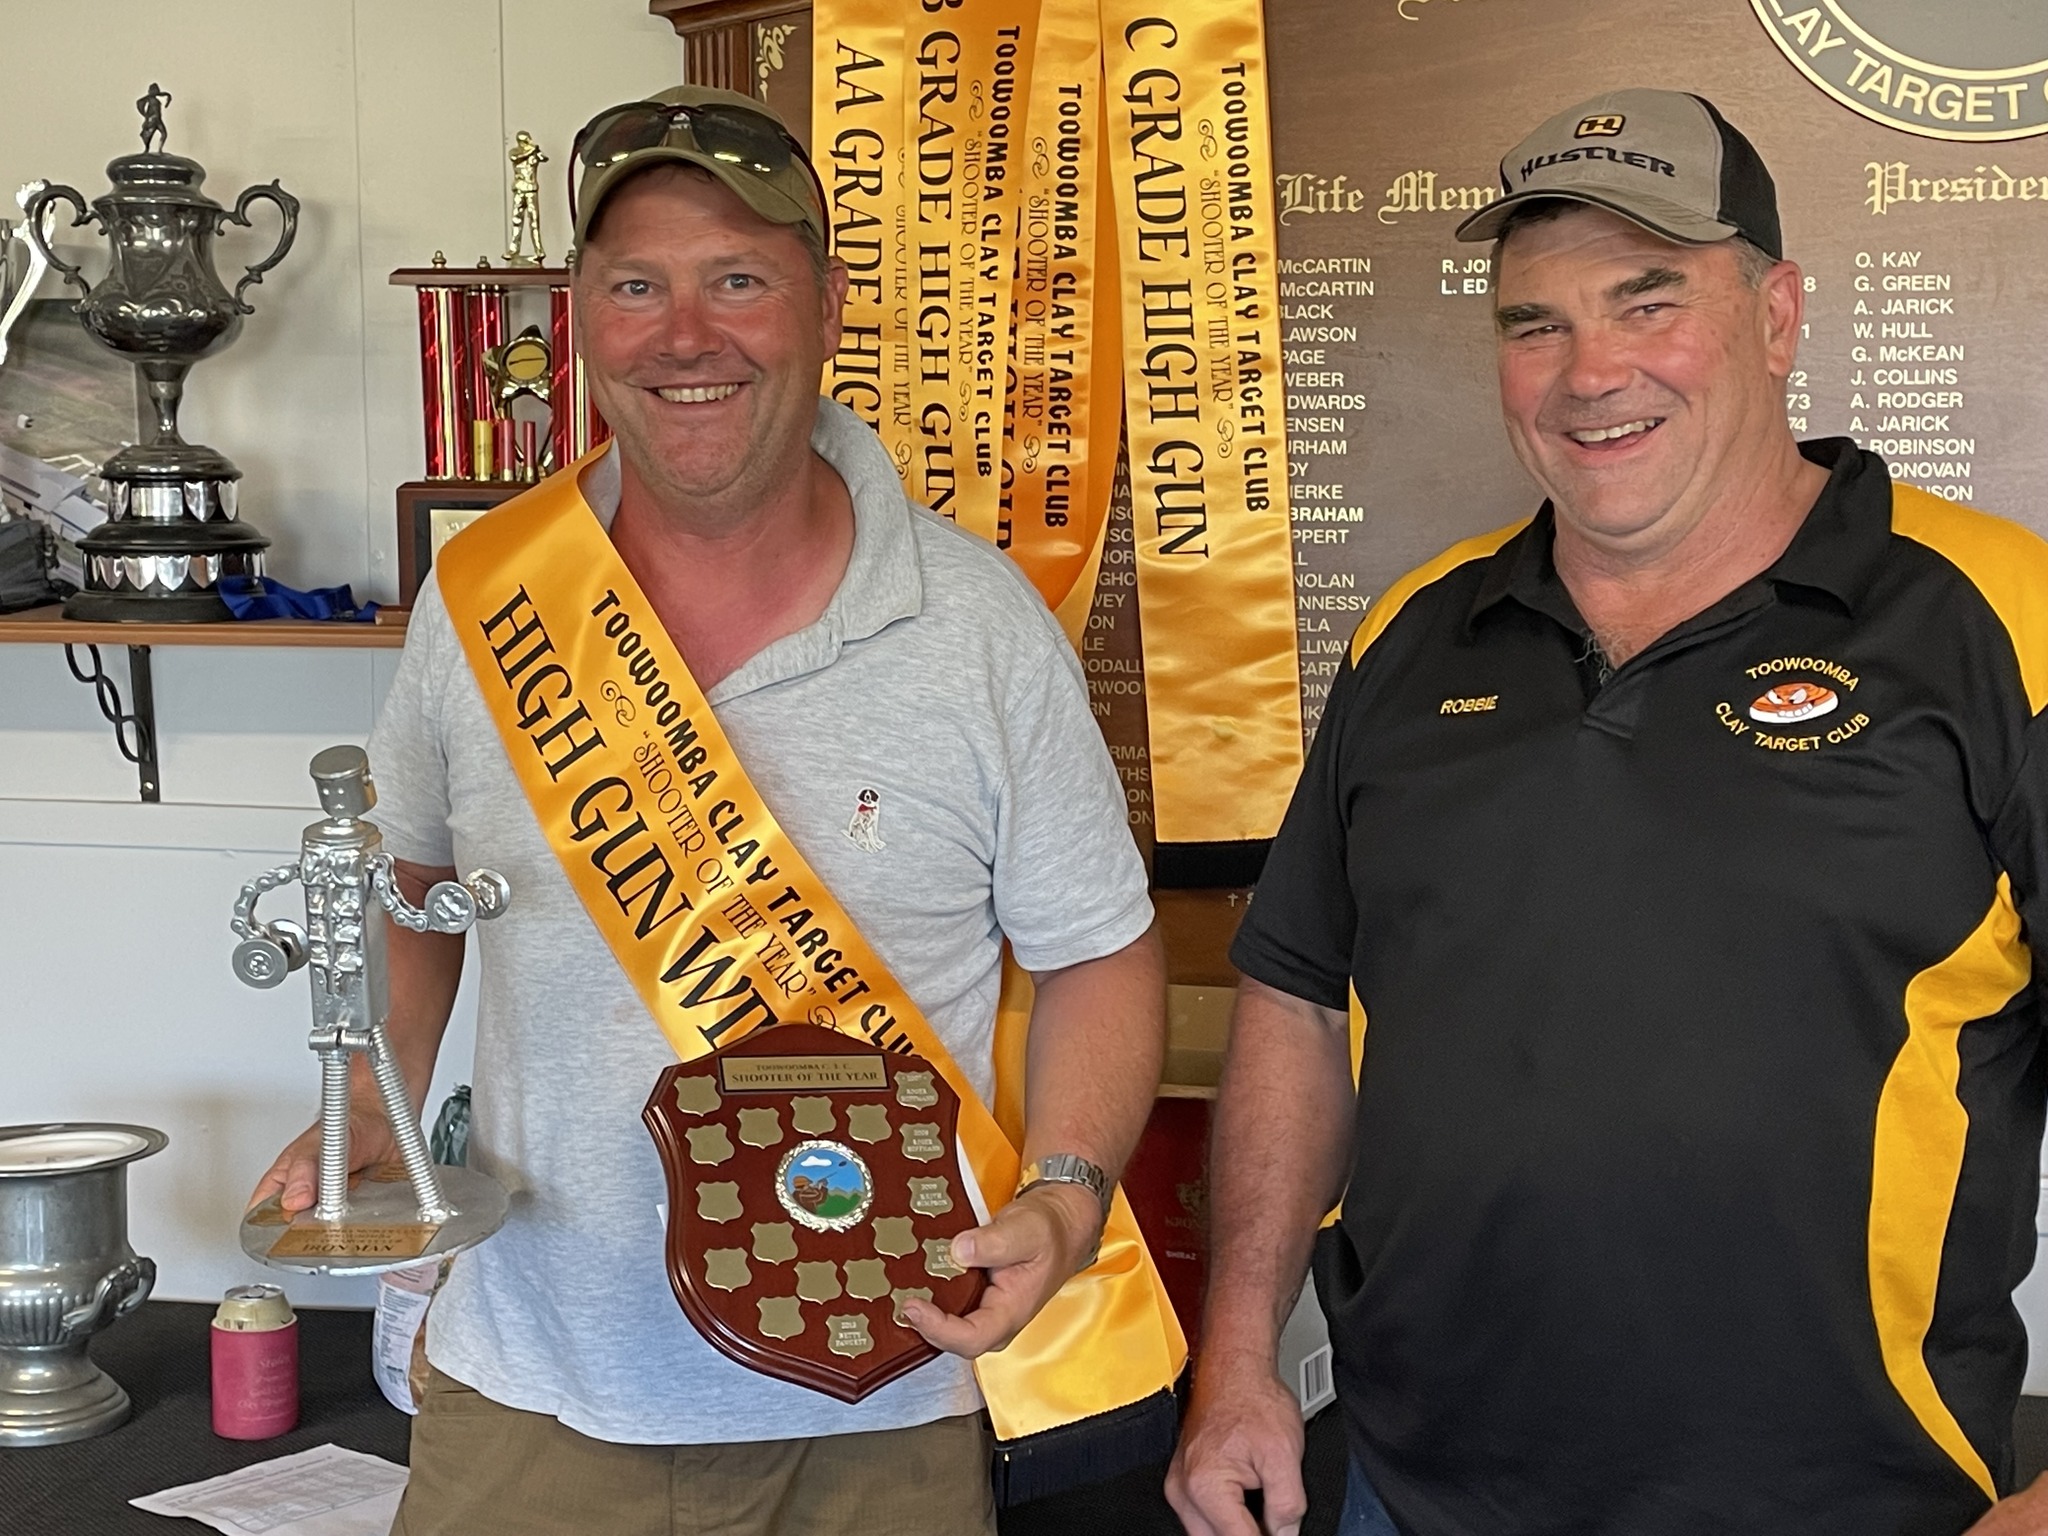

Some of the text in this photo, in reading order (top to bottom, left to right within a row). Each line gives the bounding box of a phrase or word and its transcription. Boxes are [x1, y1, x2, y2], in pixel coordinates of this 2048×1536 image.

[1846, 48, 2028, 122] TARGET
[915, 31, 961, 223] GRADE
[983, 25, 1020, 201] TOOWOOMBA
[1521, 147, 1676, 182] HUSTLER
[1276, 170, 1504, 226] Life Mem
[829, 38, 885, 434] AA GRADE HIG
[979, 213, 1002, 281] CLAY
[960, 243, 976, 270] OF
[1277, 258, 1371, 274] McCARTIN
[1442, 259, 1459, 274] R.
[1855, 251, 1922, 268] O. KAY
[959, 277, 975, 311] THE
[1122, 17, 1210, 559] C GRADE HIGH GUN
[1206, 282, 1228, 309] OF
[1221, 62, 1270, 513] TOOWOOMBA CLAY TARGET CLUB
[1280, 281, 1374, 297] McCARTIN
[1441, 279, 1458, 295] L.
[1854, 275, 1951, 292] G. GREEN
[916, 240, 951, 386] HIGH
[1025, 300, 1046, 327] OF
[1045, 84, 1082, 528] TOOWOOMBA CLAY TARGET CLUB
[1853, 298, 1955, 315] A. JARICK
[976, 292, 997, 399] TARGET
[1207, 318, 1231, 349] THE
[1853, 322, 1933, 339] W. HULL
[1023, 333, 1045, 366] THE
[1851, 345, 1965, 363] G. McKEAN
[1850, 368, 1958, 386] J. COLLINS
[1850, 392, 1964, 409] A. RODGER
[1849, 415, 1950, 432] A. JARICK
[974, 411, 993, 478] CLUB
[1870, 439, 1975, 455] ROBINSON
[1297, 595, 1371, 611] NNESSY
[1745, 656, 1860, 691] TOOWOOMBA
[1440, 695, 1499, 716] ROBBIE
[1715, 701, 1871, 752] CLAY TARGET CLUB
[479, 584, 608, 783] HIGH
[570, 775, 695, 941] GUN
[590, 588, 719, 800] TOOWOOMBA
[707, 799, 780, 886] CLAY
[767, 886, 870, 1005] TARGET
[696, 858, 735, 895] OF
[721, 893, 768, 940] THE
[731, 1072, 879, 1083] SHOOTER OF THE YEAR
[302, 1244, 395, 1252] IRON MAN
